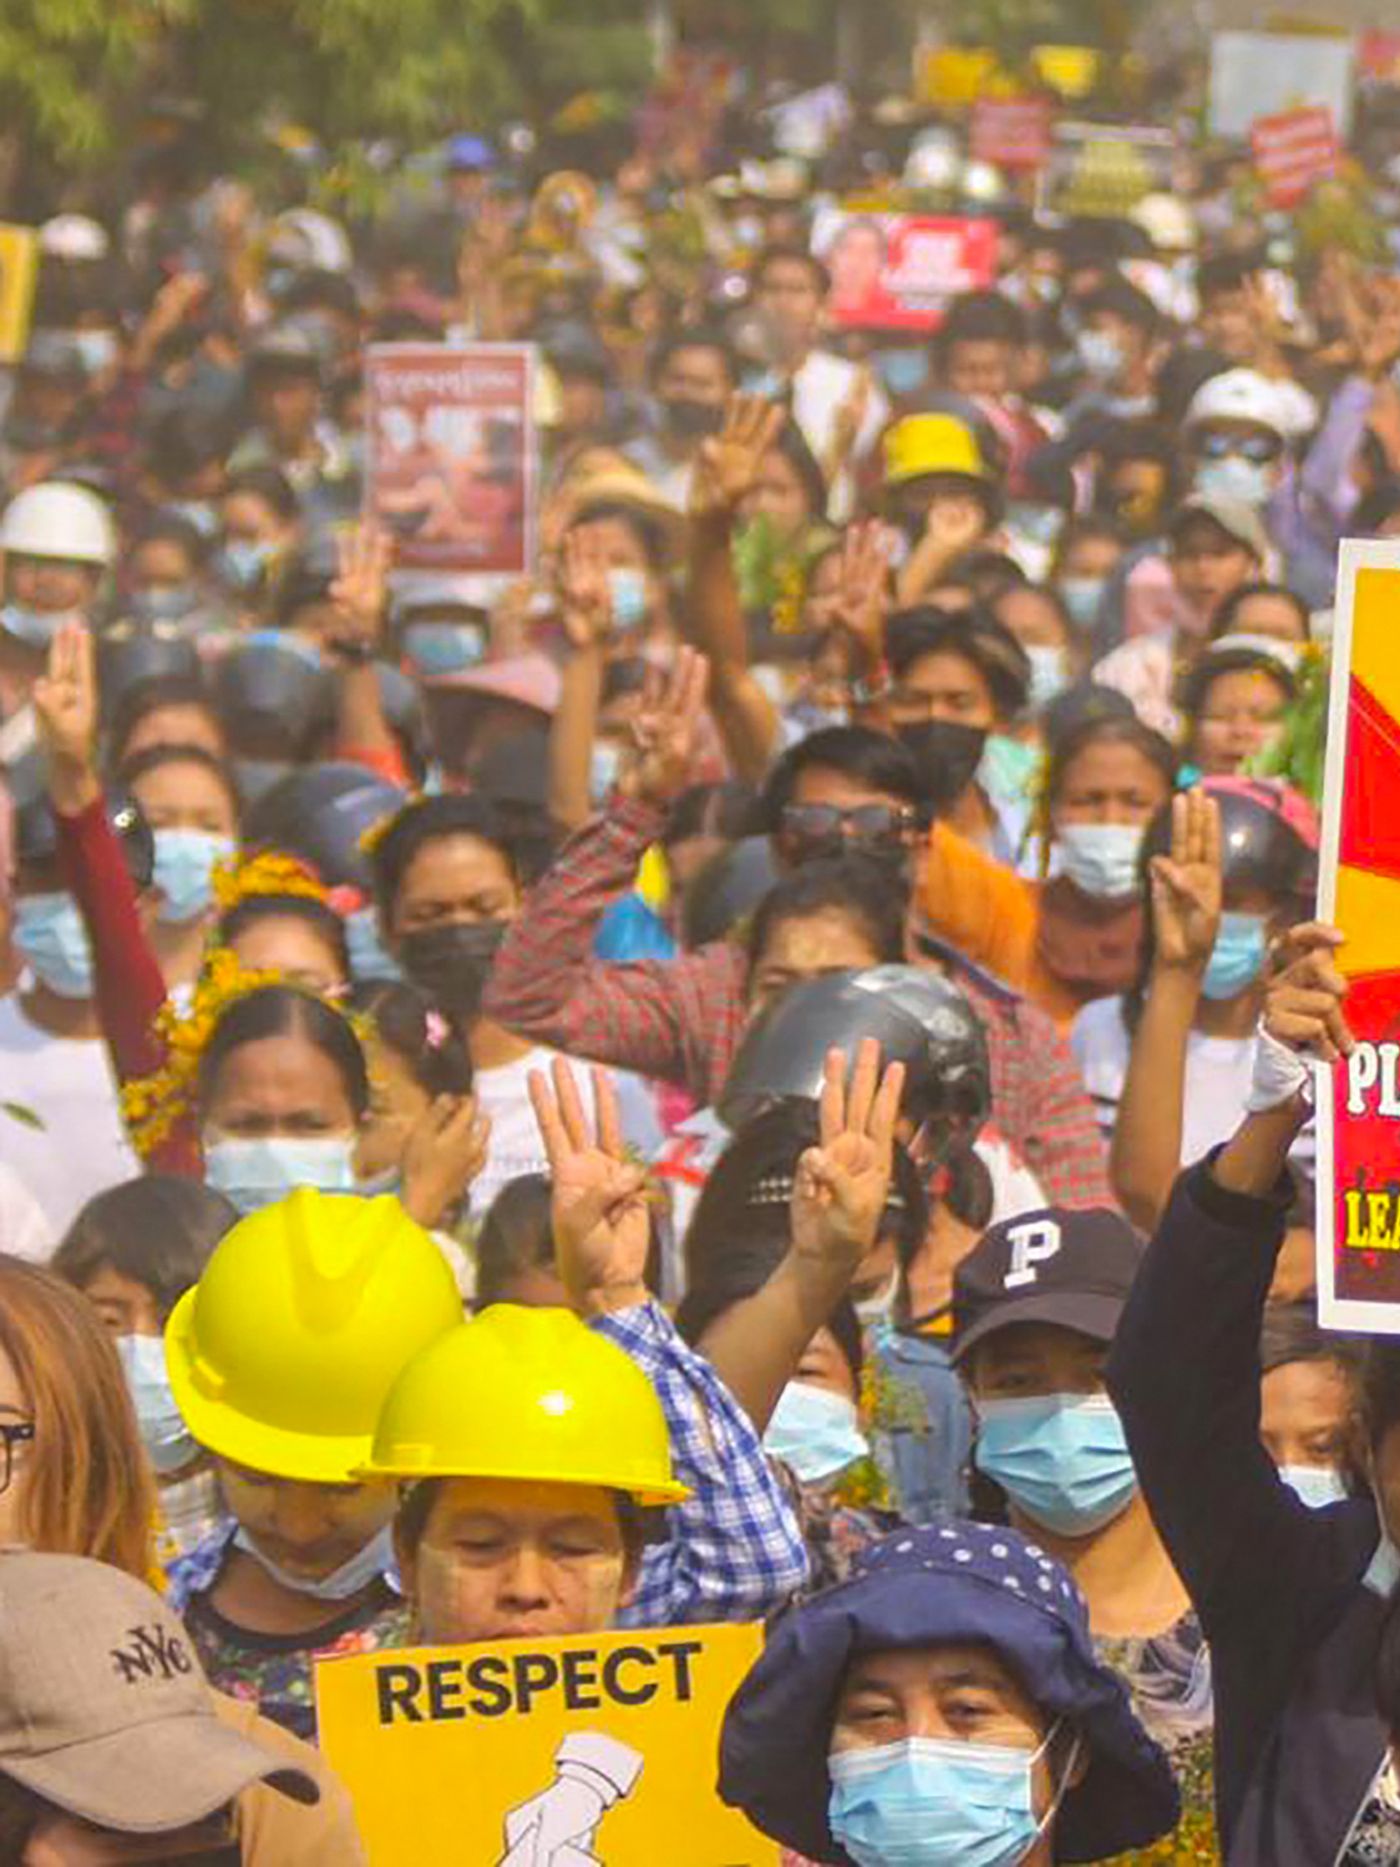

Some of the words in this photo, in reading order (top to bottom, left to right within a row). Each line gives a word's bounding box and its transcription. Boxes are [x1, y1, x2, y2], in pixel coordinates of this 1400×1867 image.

[1004, 1219, 1062, 1290] P
[109, 1623, 192, 1684] NYC
[375, 1641, 702, 1724] RESPECT
